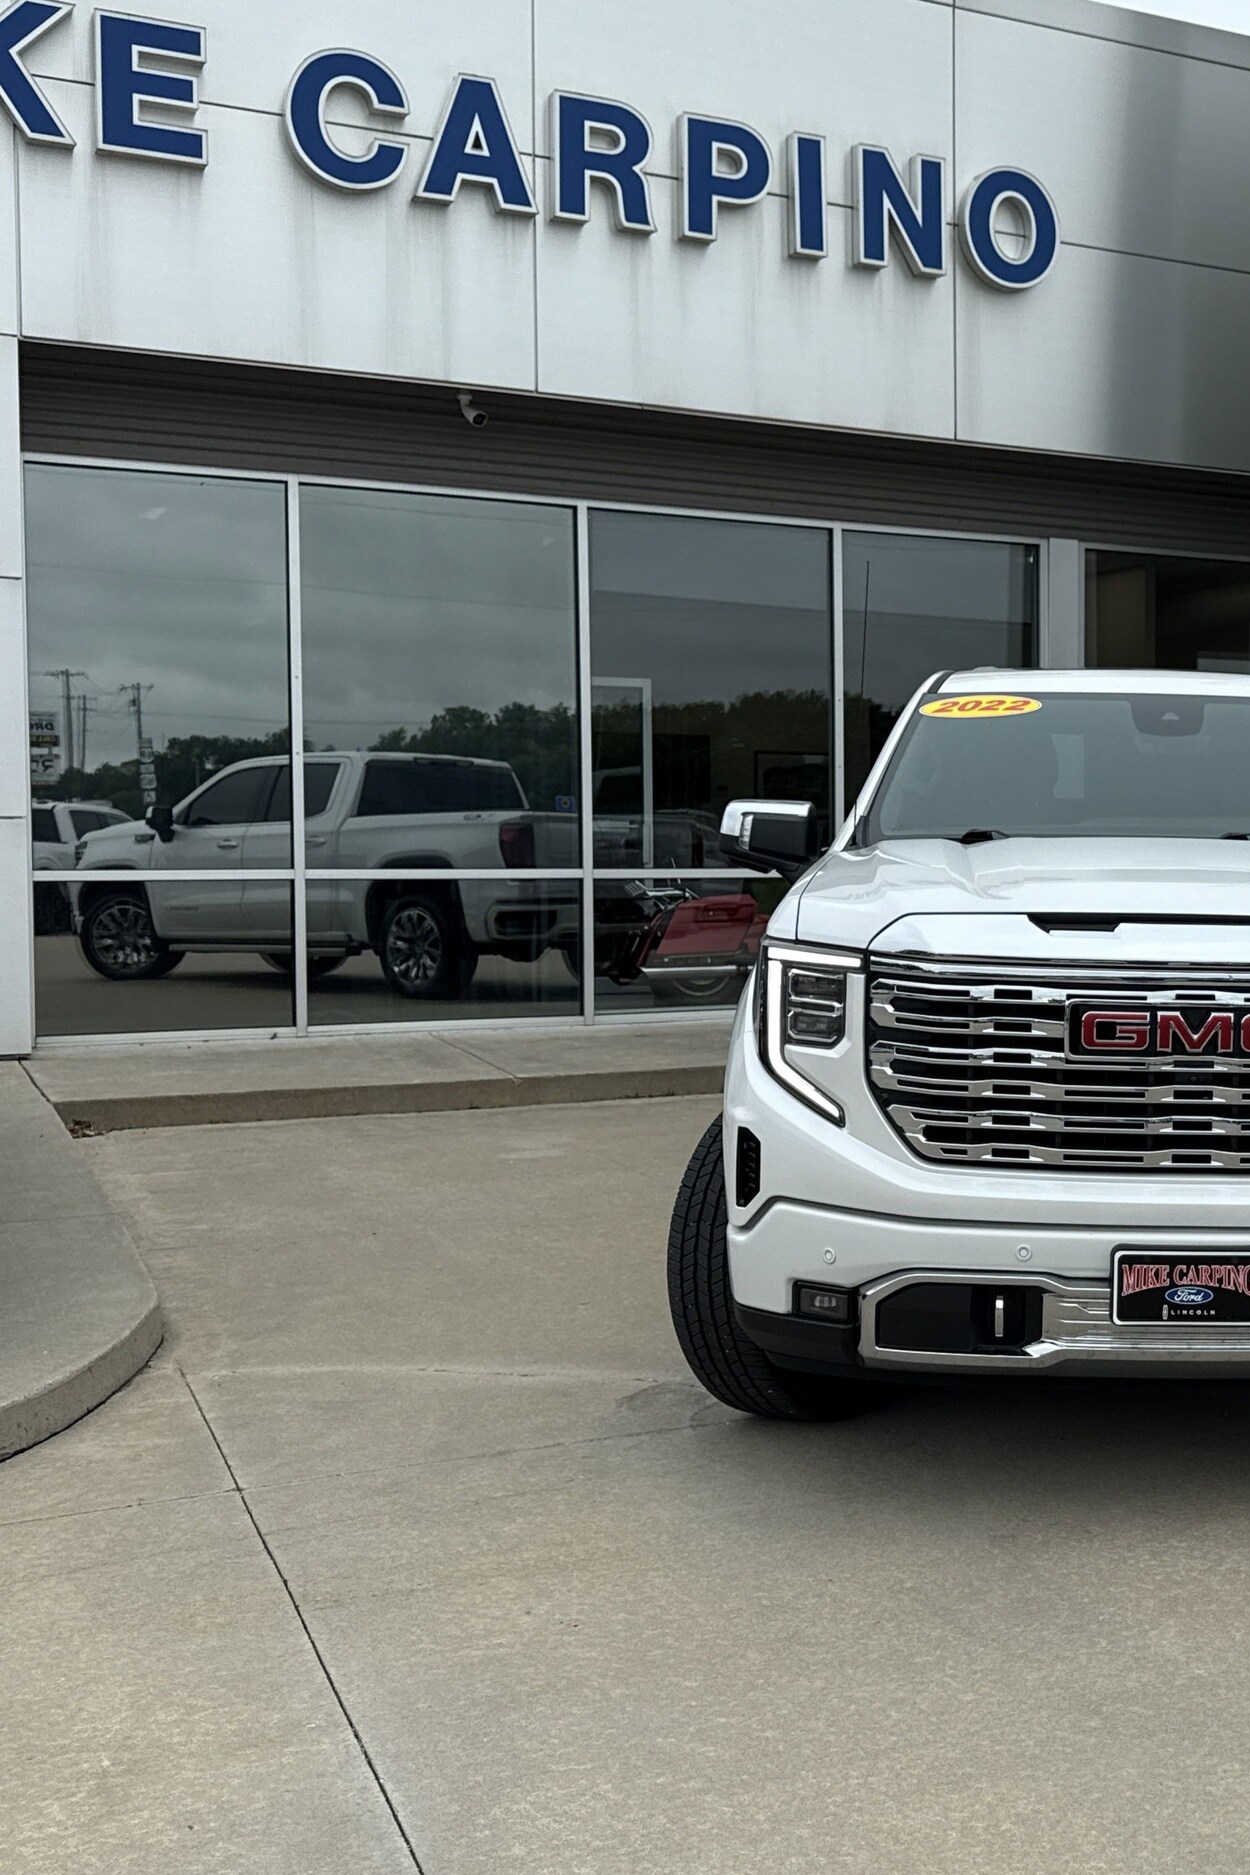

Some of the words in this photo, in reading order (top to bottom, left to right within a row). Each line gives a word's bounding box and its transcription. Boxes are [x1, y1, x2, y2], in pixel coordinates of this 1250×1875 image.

[283, 47, 1060, 291] CARPINO
[931, 699, 1032, 714] 2022
[1121, 1264, 1170, 1296] MIKE
[1174, 1288, 1204, 1302] Ford
